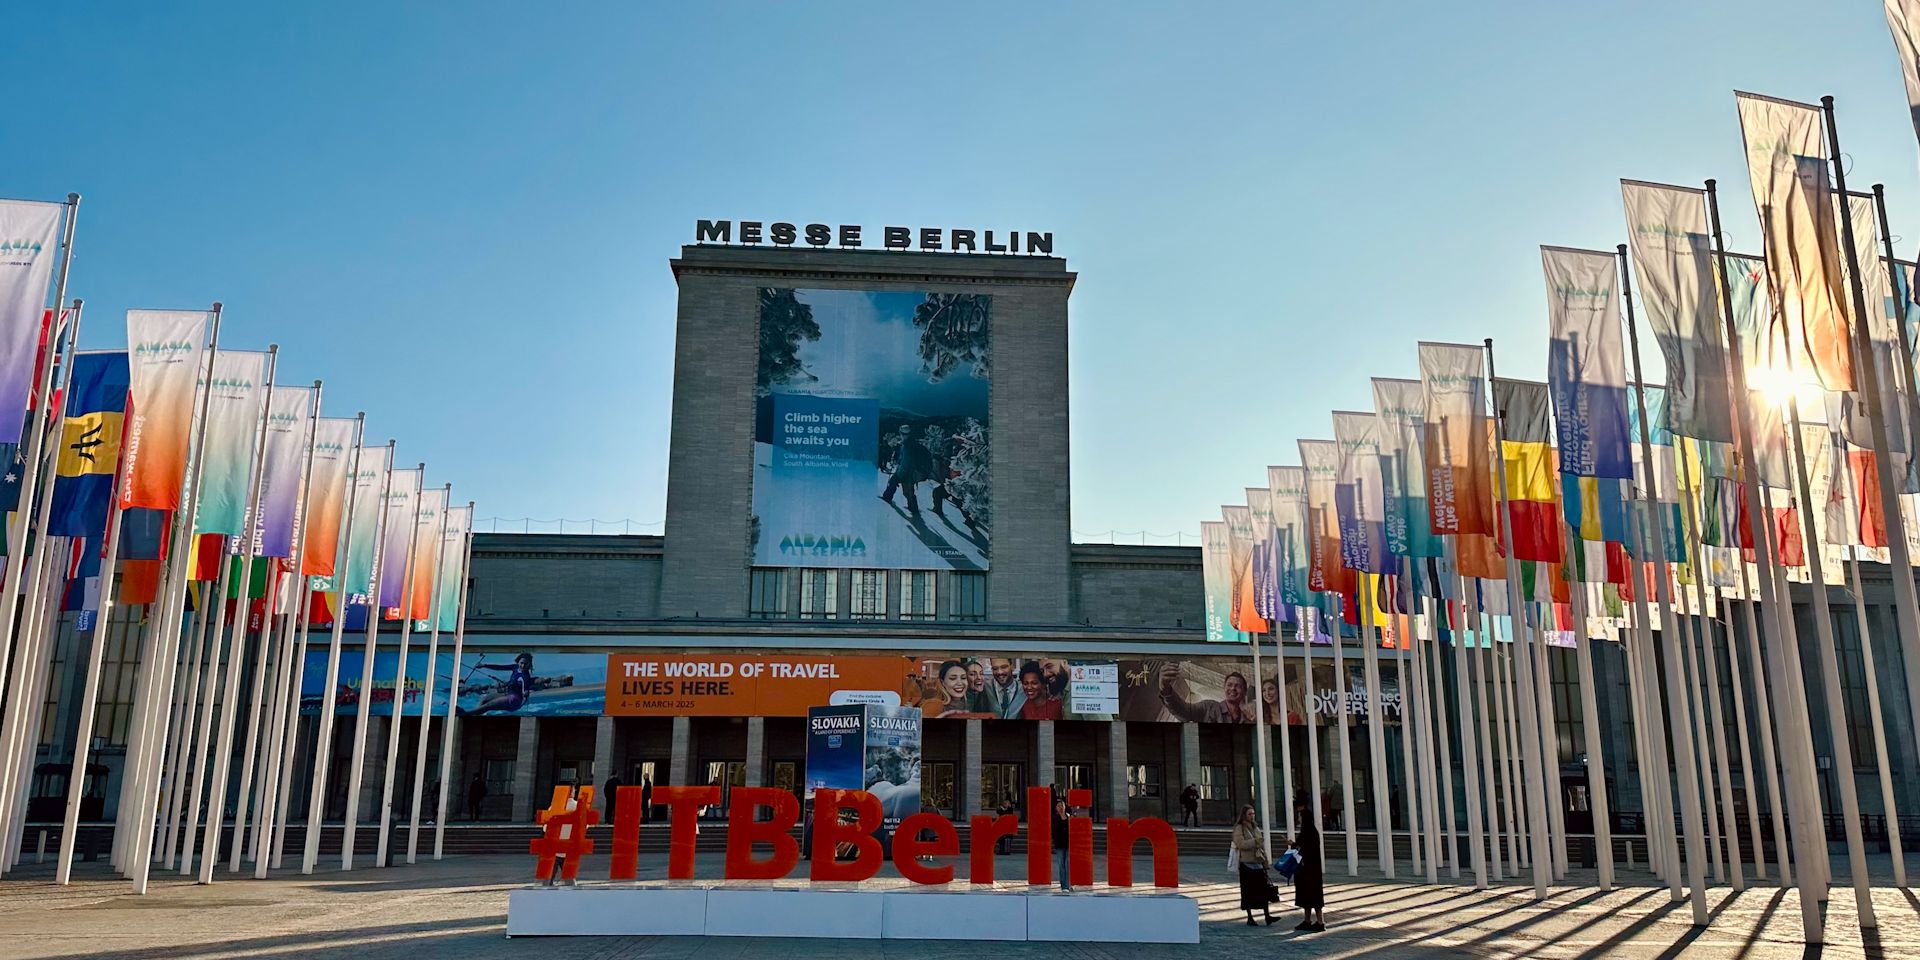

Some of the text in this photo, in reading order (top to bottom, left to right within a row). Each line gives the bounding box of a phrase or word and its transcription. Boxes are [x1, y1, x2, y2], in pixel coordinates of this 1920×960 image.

[696, 219, 1053, 253] MESSE BERLIN
[784, 413, 862, 425] Climb higher
[784, 424, 828, 434] the sea
[785, 435, 849, 447] awaits you
[779, 534, 866, 550] ALBANIA
[623, 662, 840, 679] THE WORLD OF TRAVEL
[622, 681, 735, 696] LIVES HERE.
[1305, 694, 1401, 716] DIVERSTY
[812, 717, 860, 730] SLOVAKIA
[871, 717, 917, 731] SLOVAKIA
[530, 784, 1179, 889] #ITBBerlin
